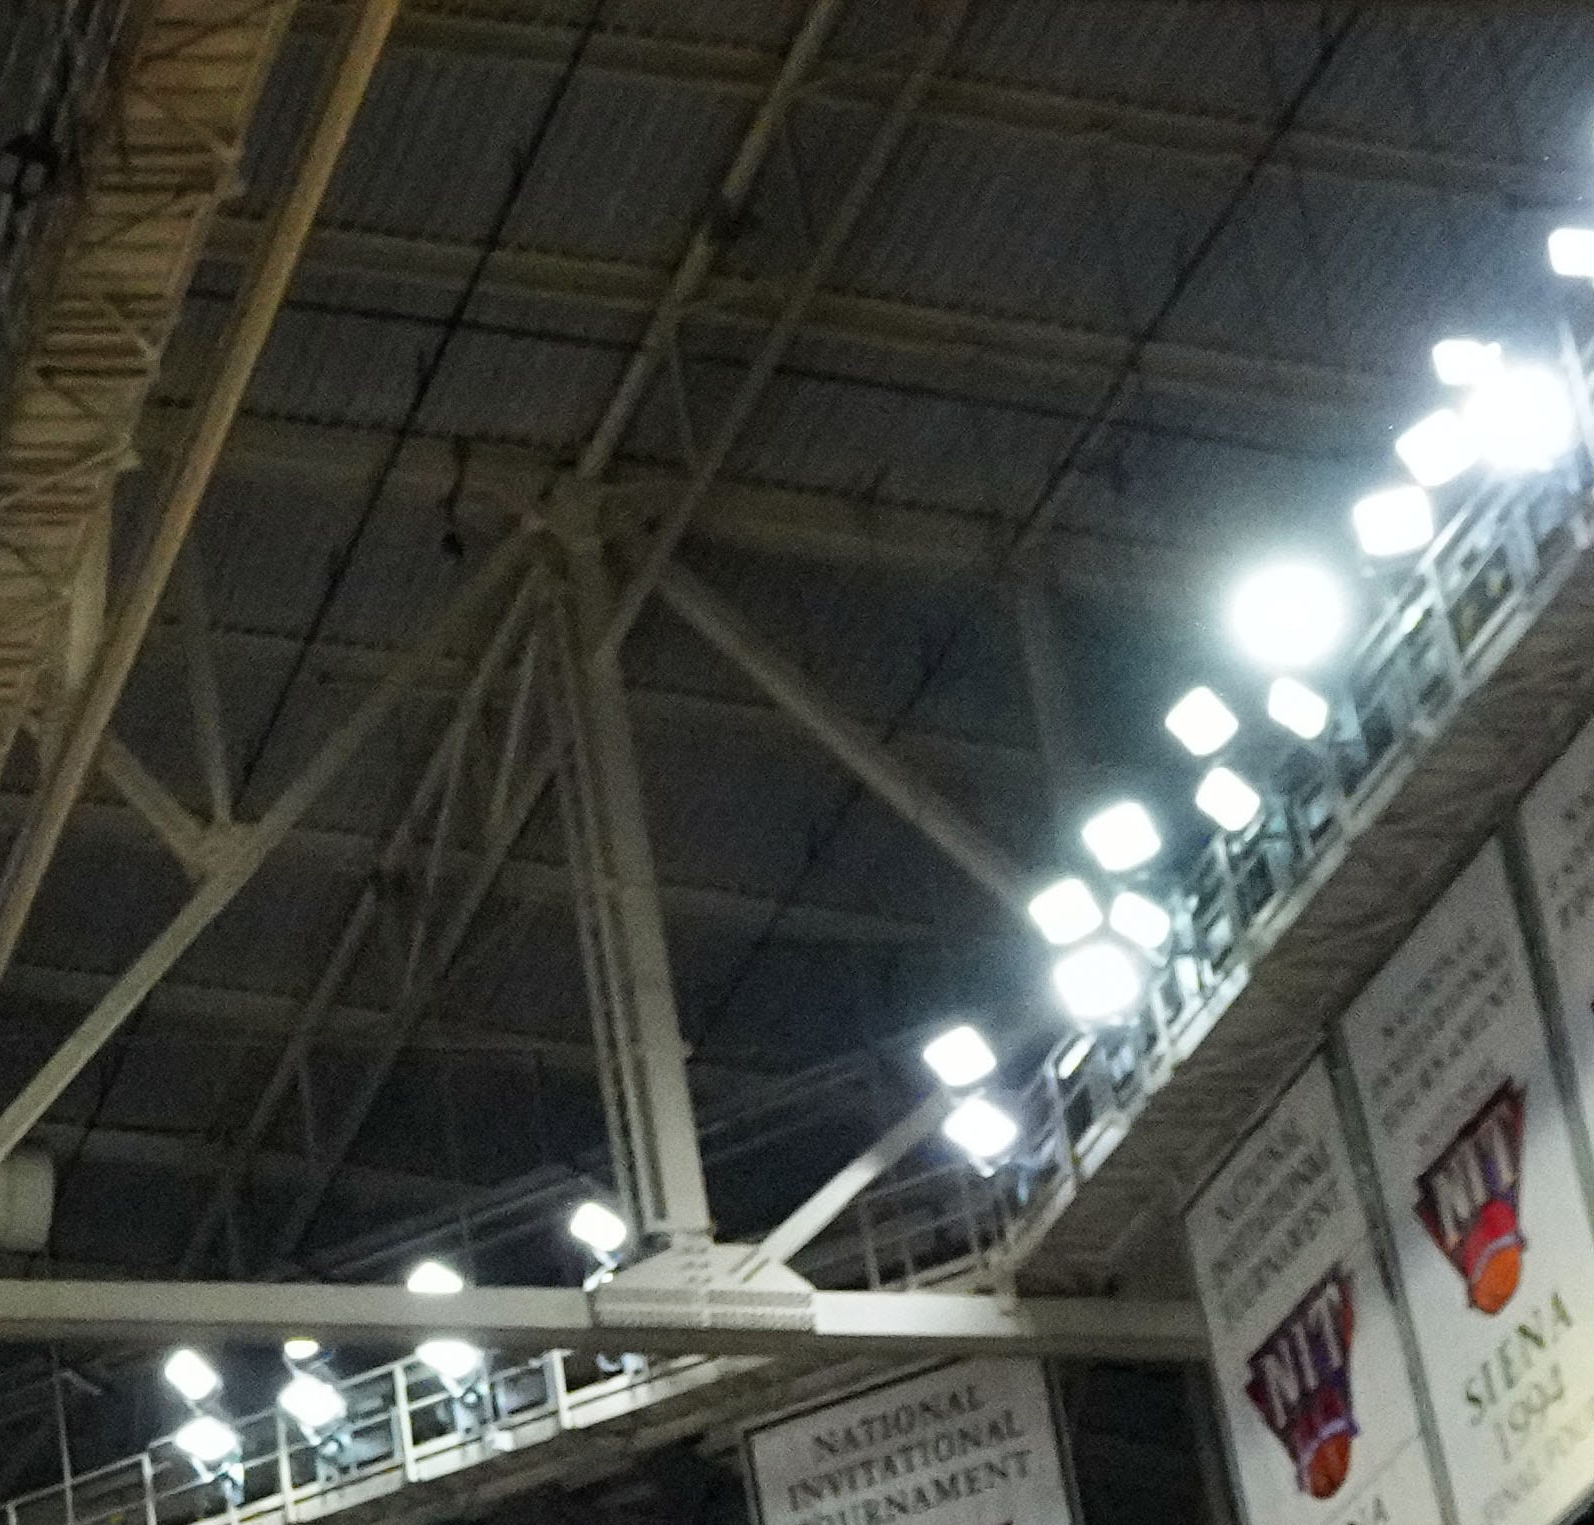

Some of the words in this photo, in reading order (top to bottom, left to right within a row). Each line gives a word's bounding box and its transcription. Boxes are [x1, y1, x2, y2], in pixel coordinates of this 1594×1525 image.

[1259, 1278, 1345, 1430] NIT
[787, 1410, 1026, 1513] INVITATIONAL
[812, 1384, 986, 1462] NATIONAL
